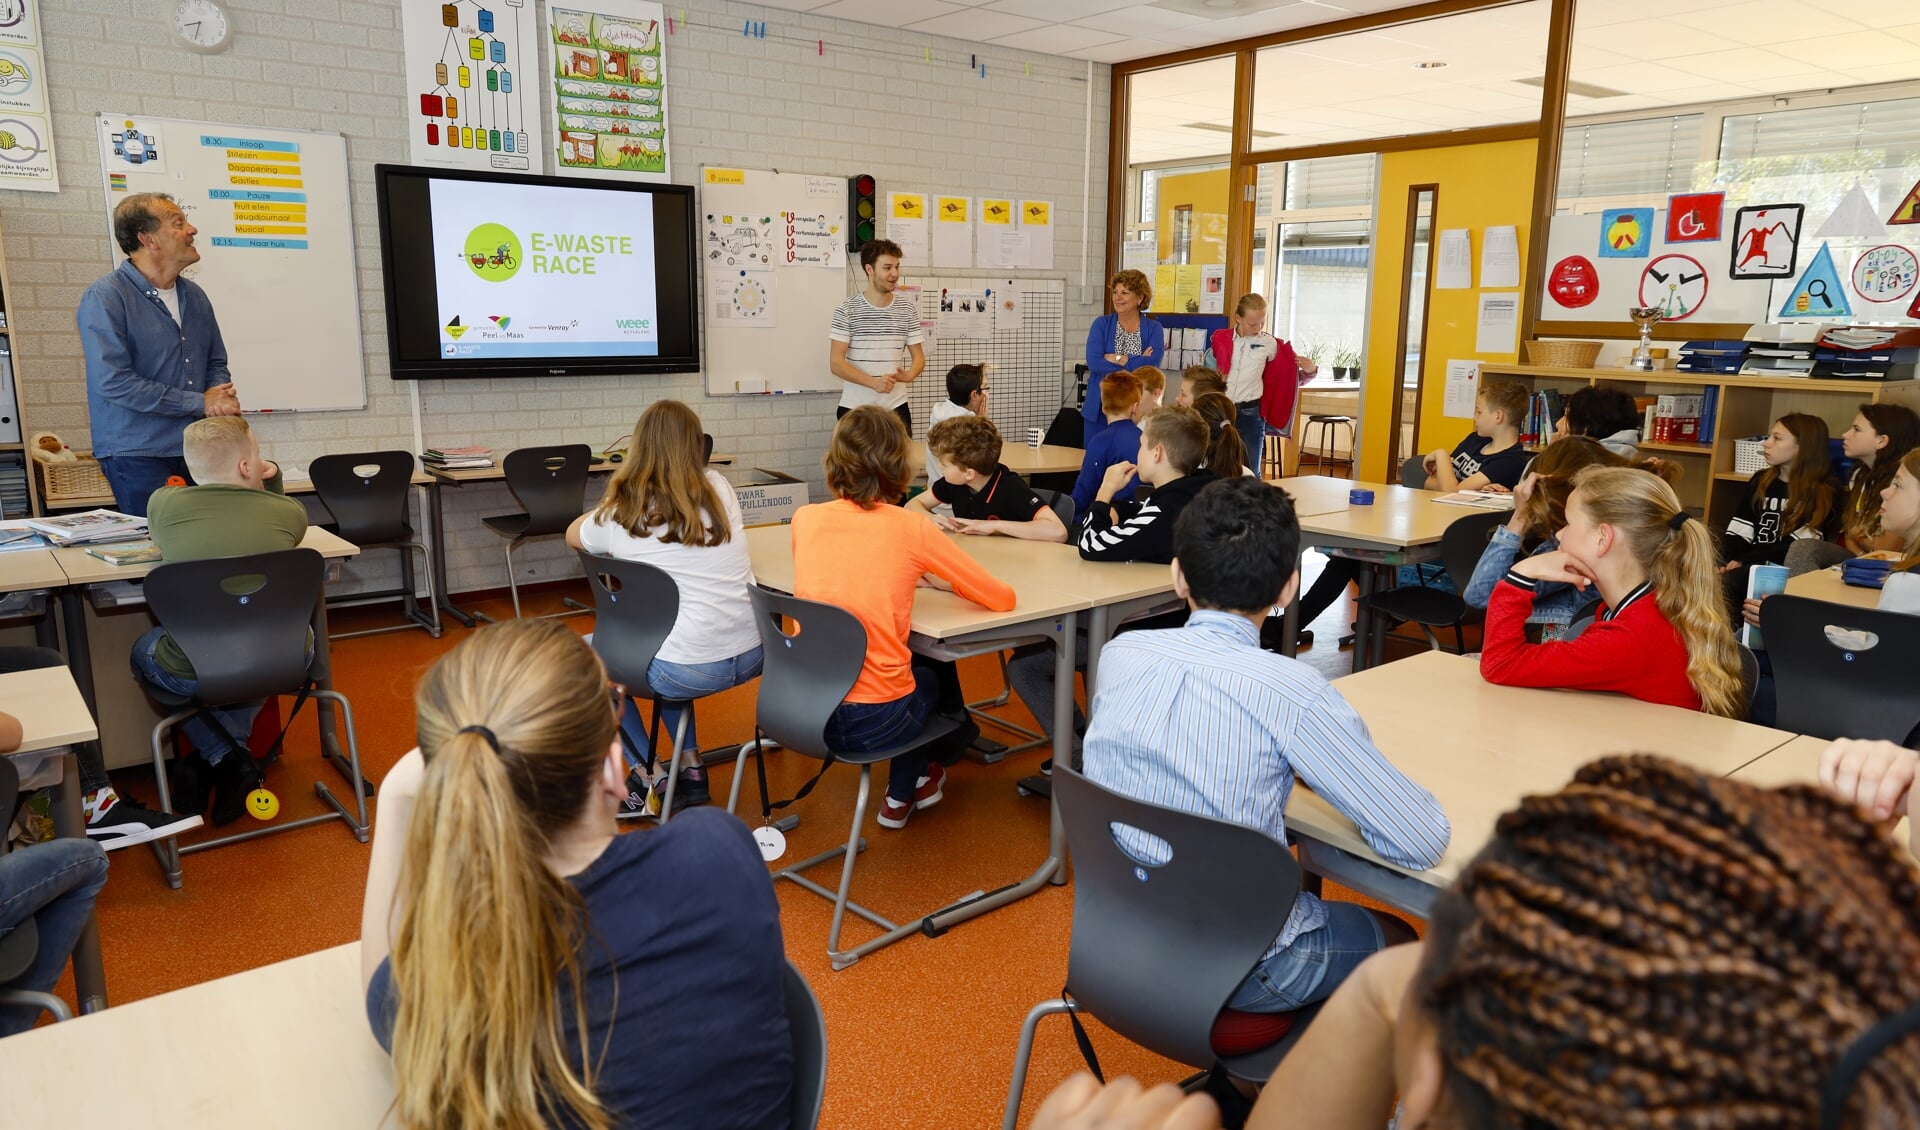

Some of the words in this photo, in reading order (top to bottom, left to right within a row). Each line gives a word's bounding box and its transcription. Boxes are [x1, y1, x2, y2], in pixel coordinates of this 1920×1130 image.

[240, 140, 265, 149] Inloop
[228, 163, 278, 174] Dagopening
[230, 176, 260, 185] Gastles
[247, 191, 271, 199] Pauze
[234, 202, 250, 210] Fruit
[252, 203, 270, 211] eten
[235, 212, 291, 222] Jeugdjournaal
[235, 225, 265, 233] Musical
[270, 239, 286, 248] huis
[531, 232, 633, 255] E-WASTE
[532, 254, 597, 275] RACE
[547, 324, 570, 332] Venray
[616, 319, 650, 329] weee
[624, 791, 645, 810] N
